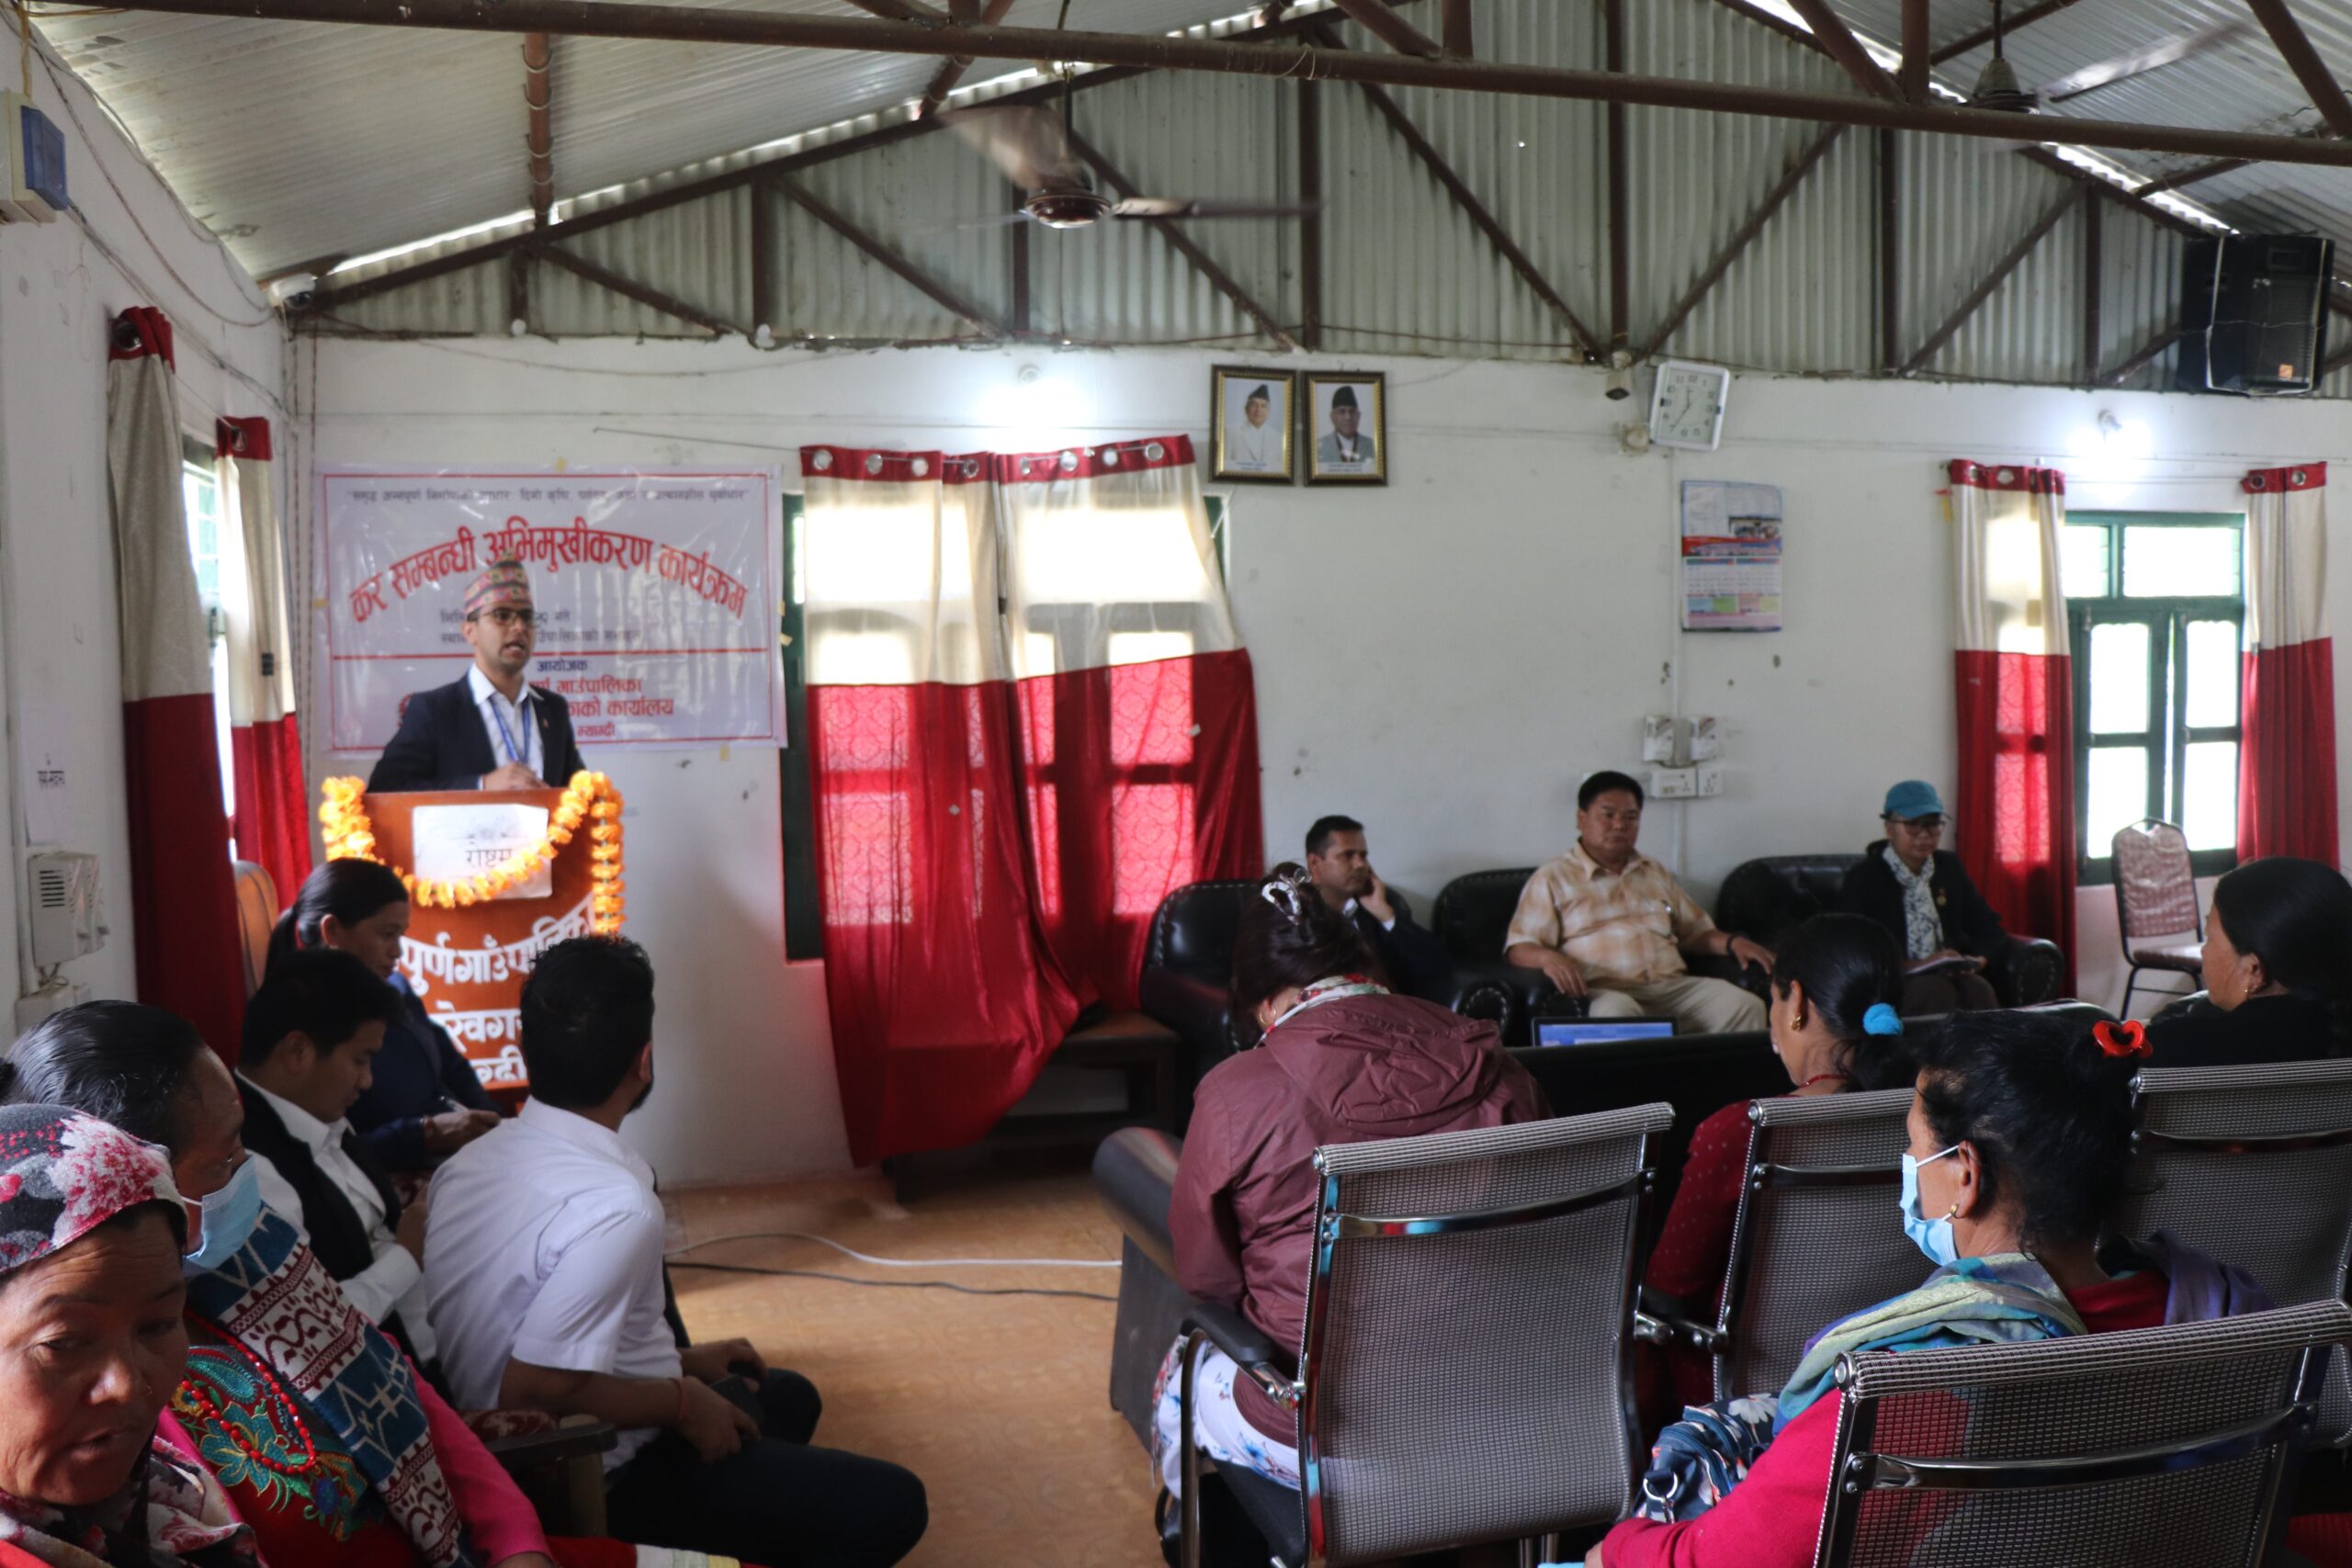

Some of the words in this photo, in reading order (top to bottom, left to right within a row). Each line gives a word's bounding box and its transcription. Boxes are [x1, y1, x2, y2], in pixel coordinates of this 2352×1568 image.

[349, 571, 389, 623] कर
[389, 525, 477, 600] सम्बन्धी
[482, 514, 655, 574] अभिमुखीकरण
[660, 544, 749, 619] कार्यक्रम
[606, 695, 674, 717] कार्यालय
